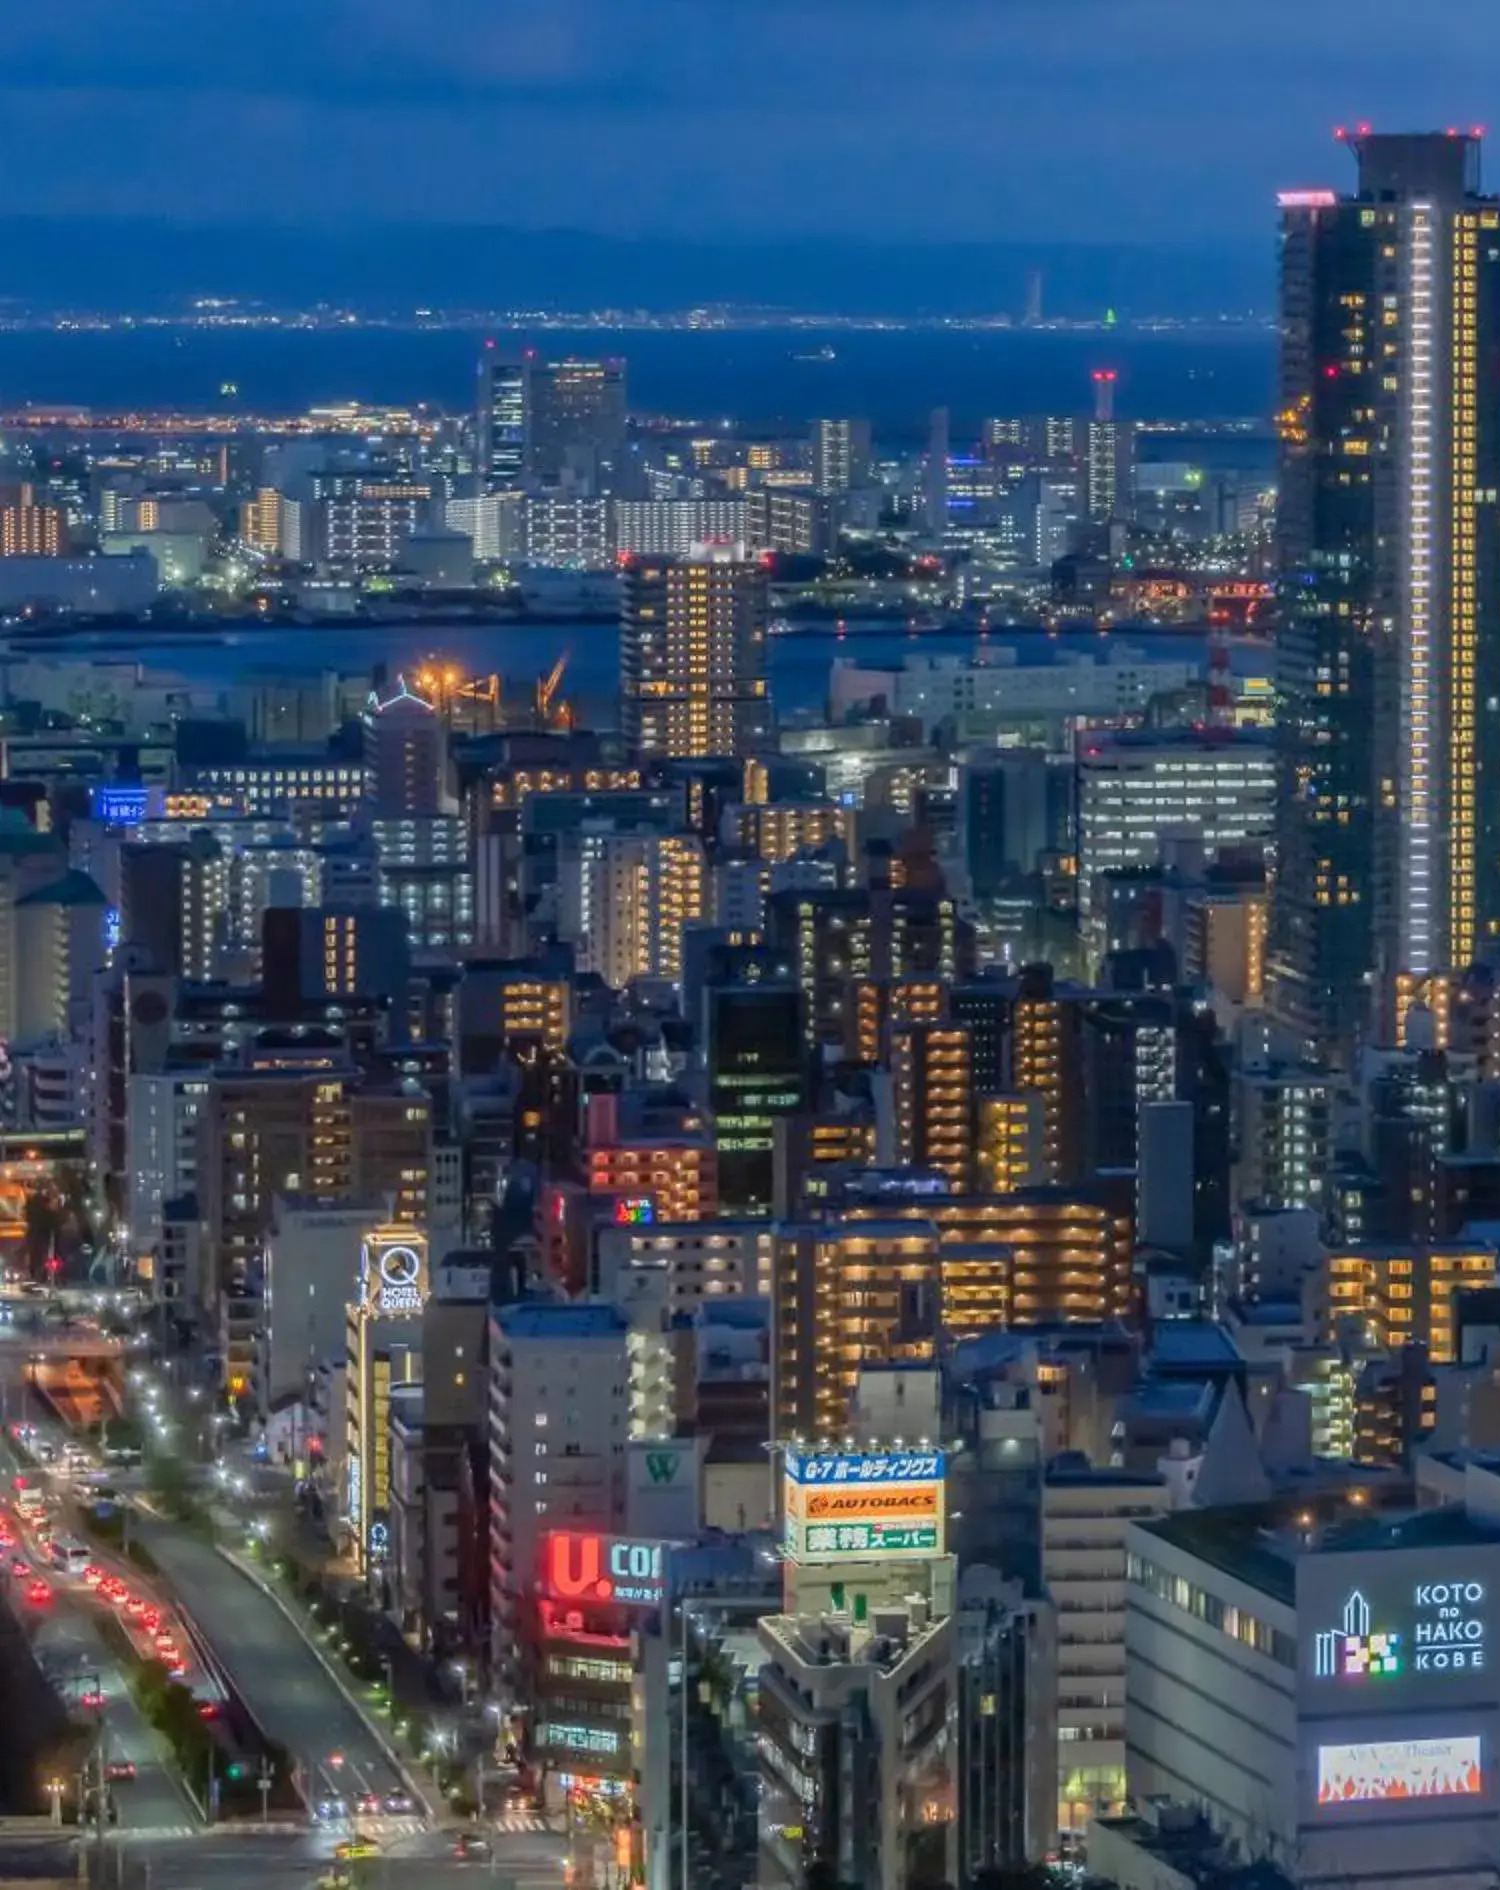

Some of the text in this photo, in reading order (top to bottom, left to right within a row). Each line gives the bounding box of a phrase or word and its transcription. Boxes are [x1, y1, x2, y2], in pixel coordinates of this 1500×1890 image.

[383, 1287, 417, 1297] HOTEL
[383, 1298, 422, 1308] QUEEN
[831, 1495, 936, 1509] AUTOBACS
[1416, 1583, 1483, 1605] KOTO
[1439, 1606, 1459, 1618] no
[1416, 1621, 1483, 1642] HAKO
[1416, 1651, 1484, 1669] KOBE
